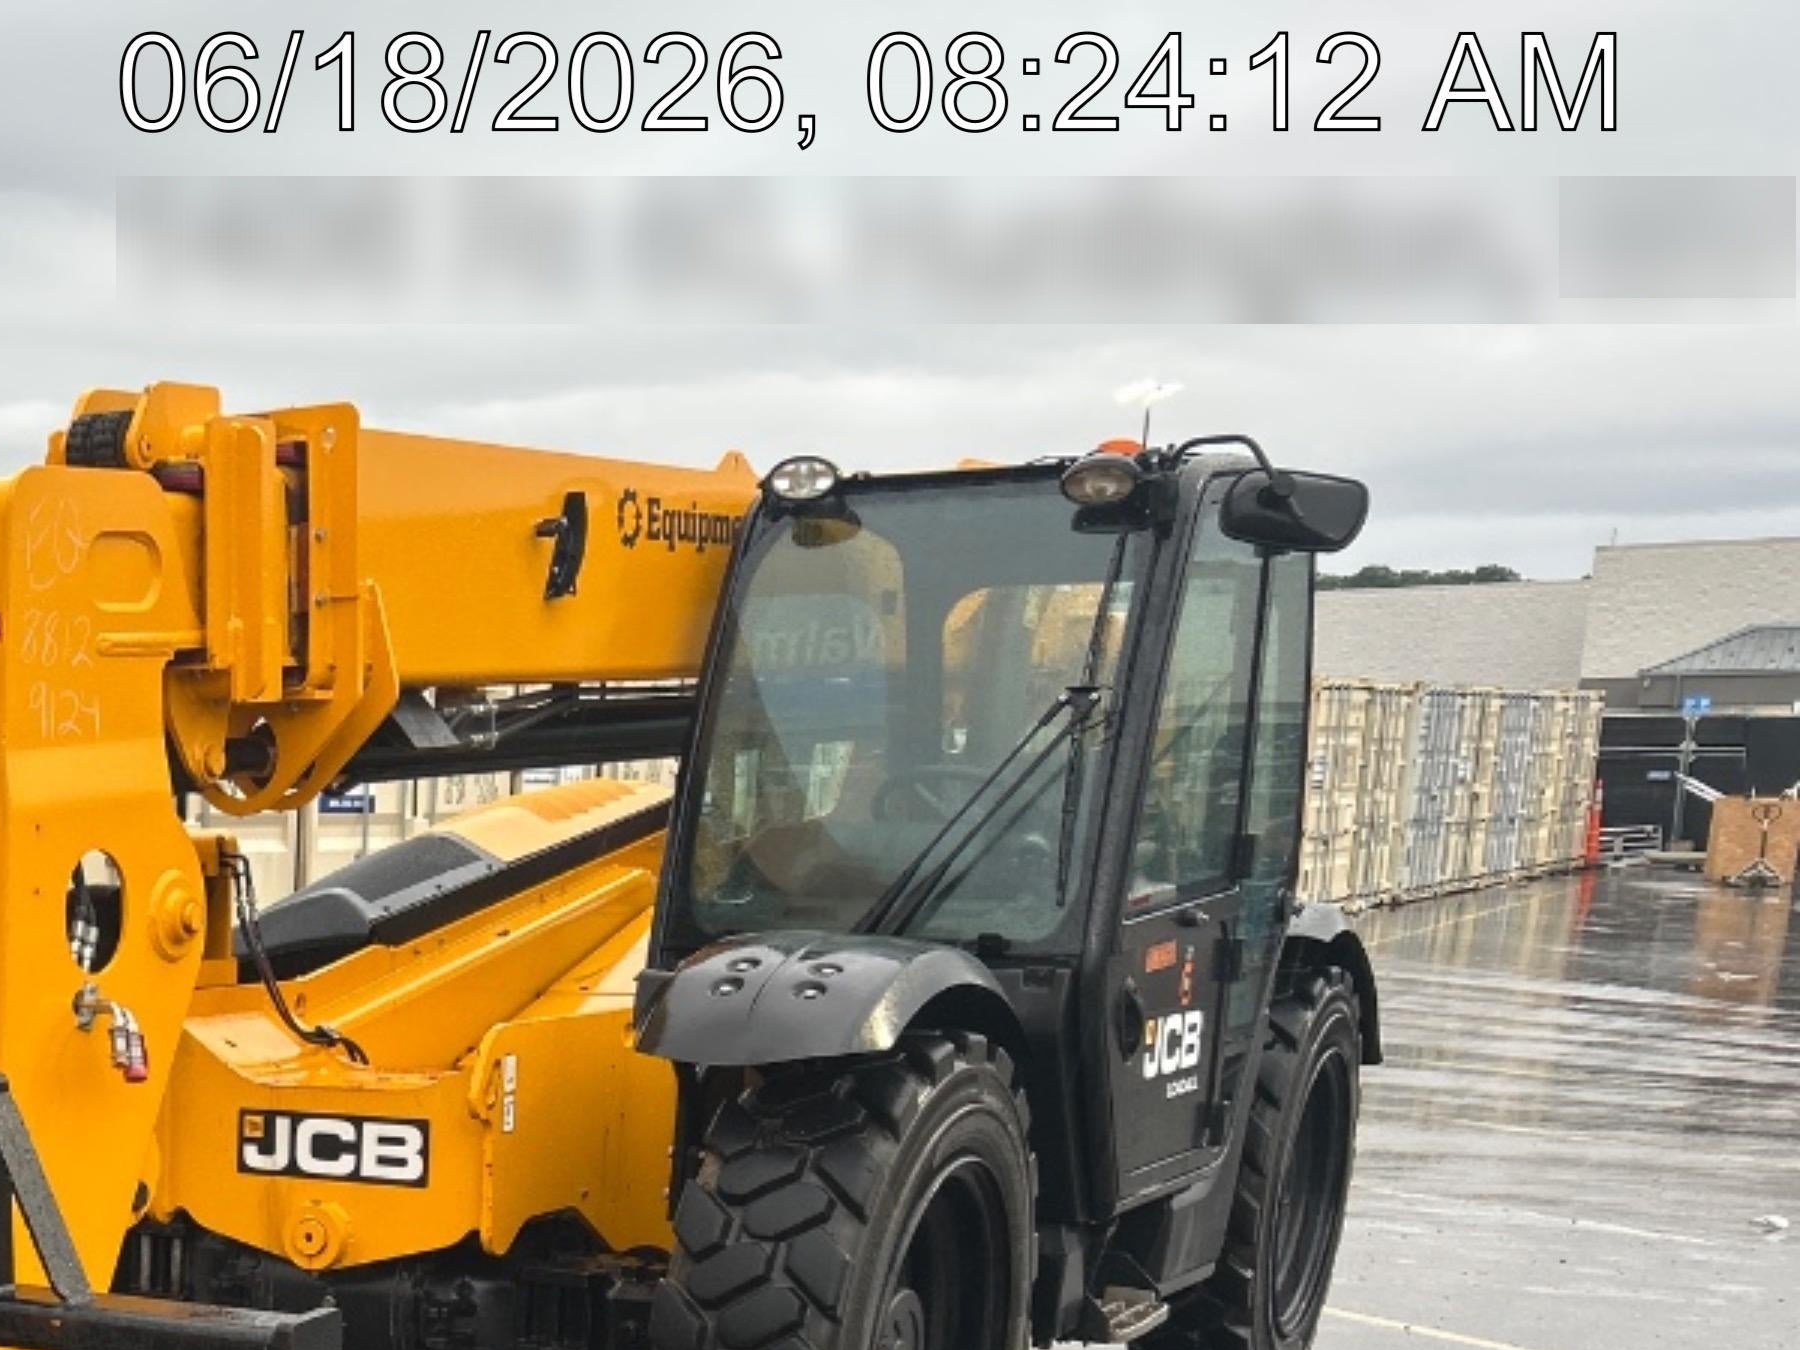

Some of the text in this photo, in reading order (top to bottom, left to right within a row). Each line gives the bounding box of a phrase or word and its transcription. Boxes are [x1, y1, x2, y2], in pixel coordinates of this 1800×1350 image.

[28, 681, 101, 741] 9124
[1142, 1010, 1203, 1080] JCB
[242, 1115, 425, 1181] JCB
